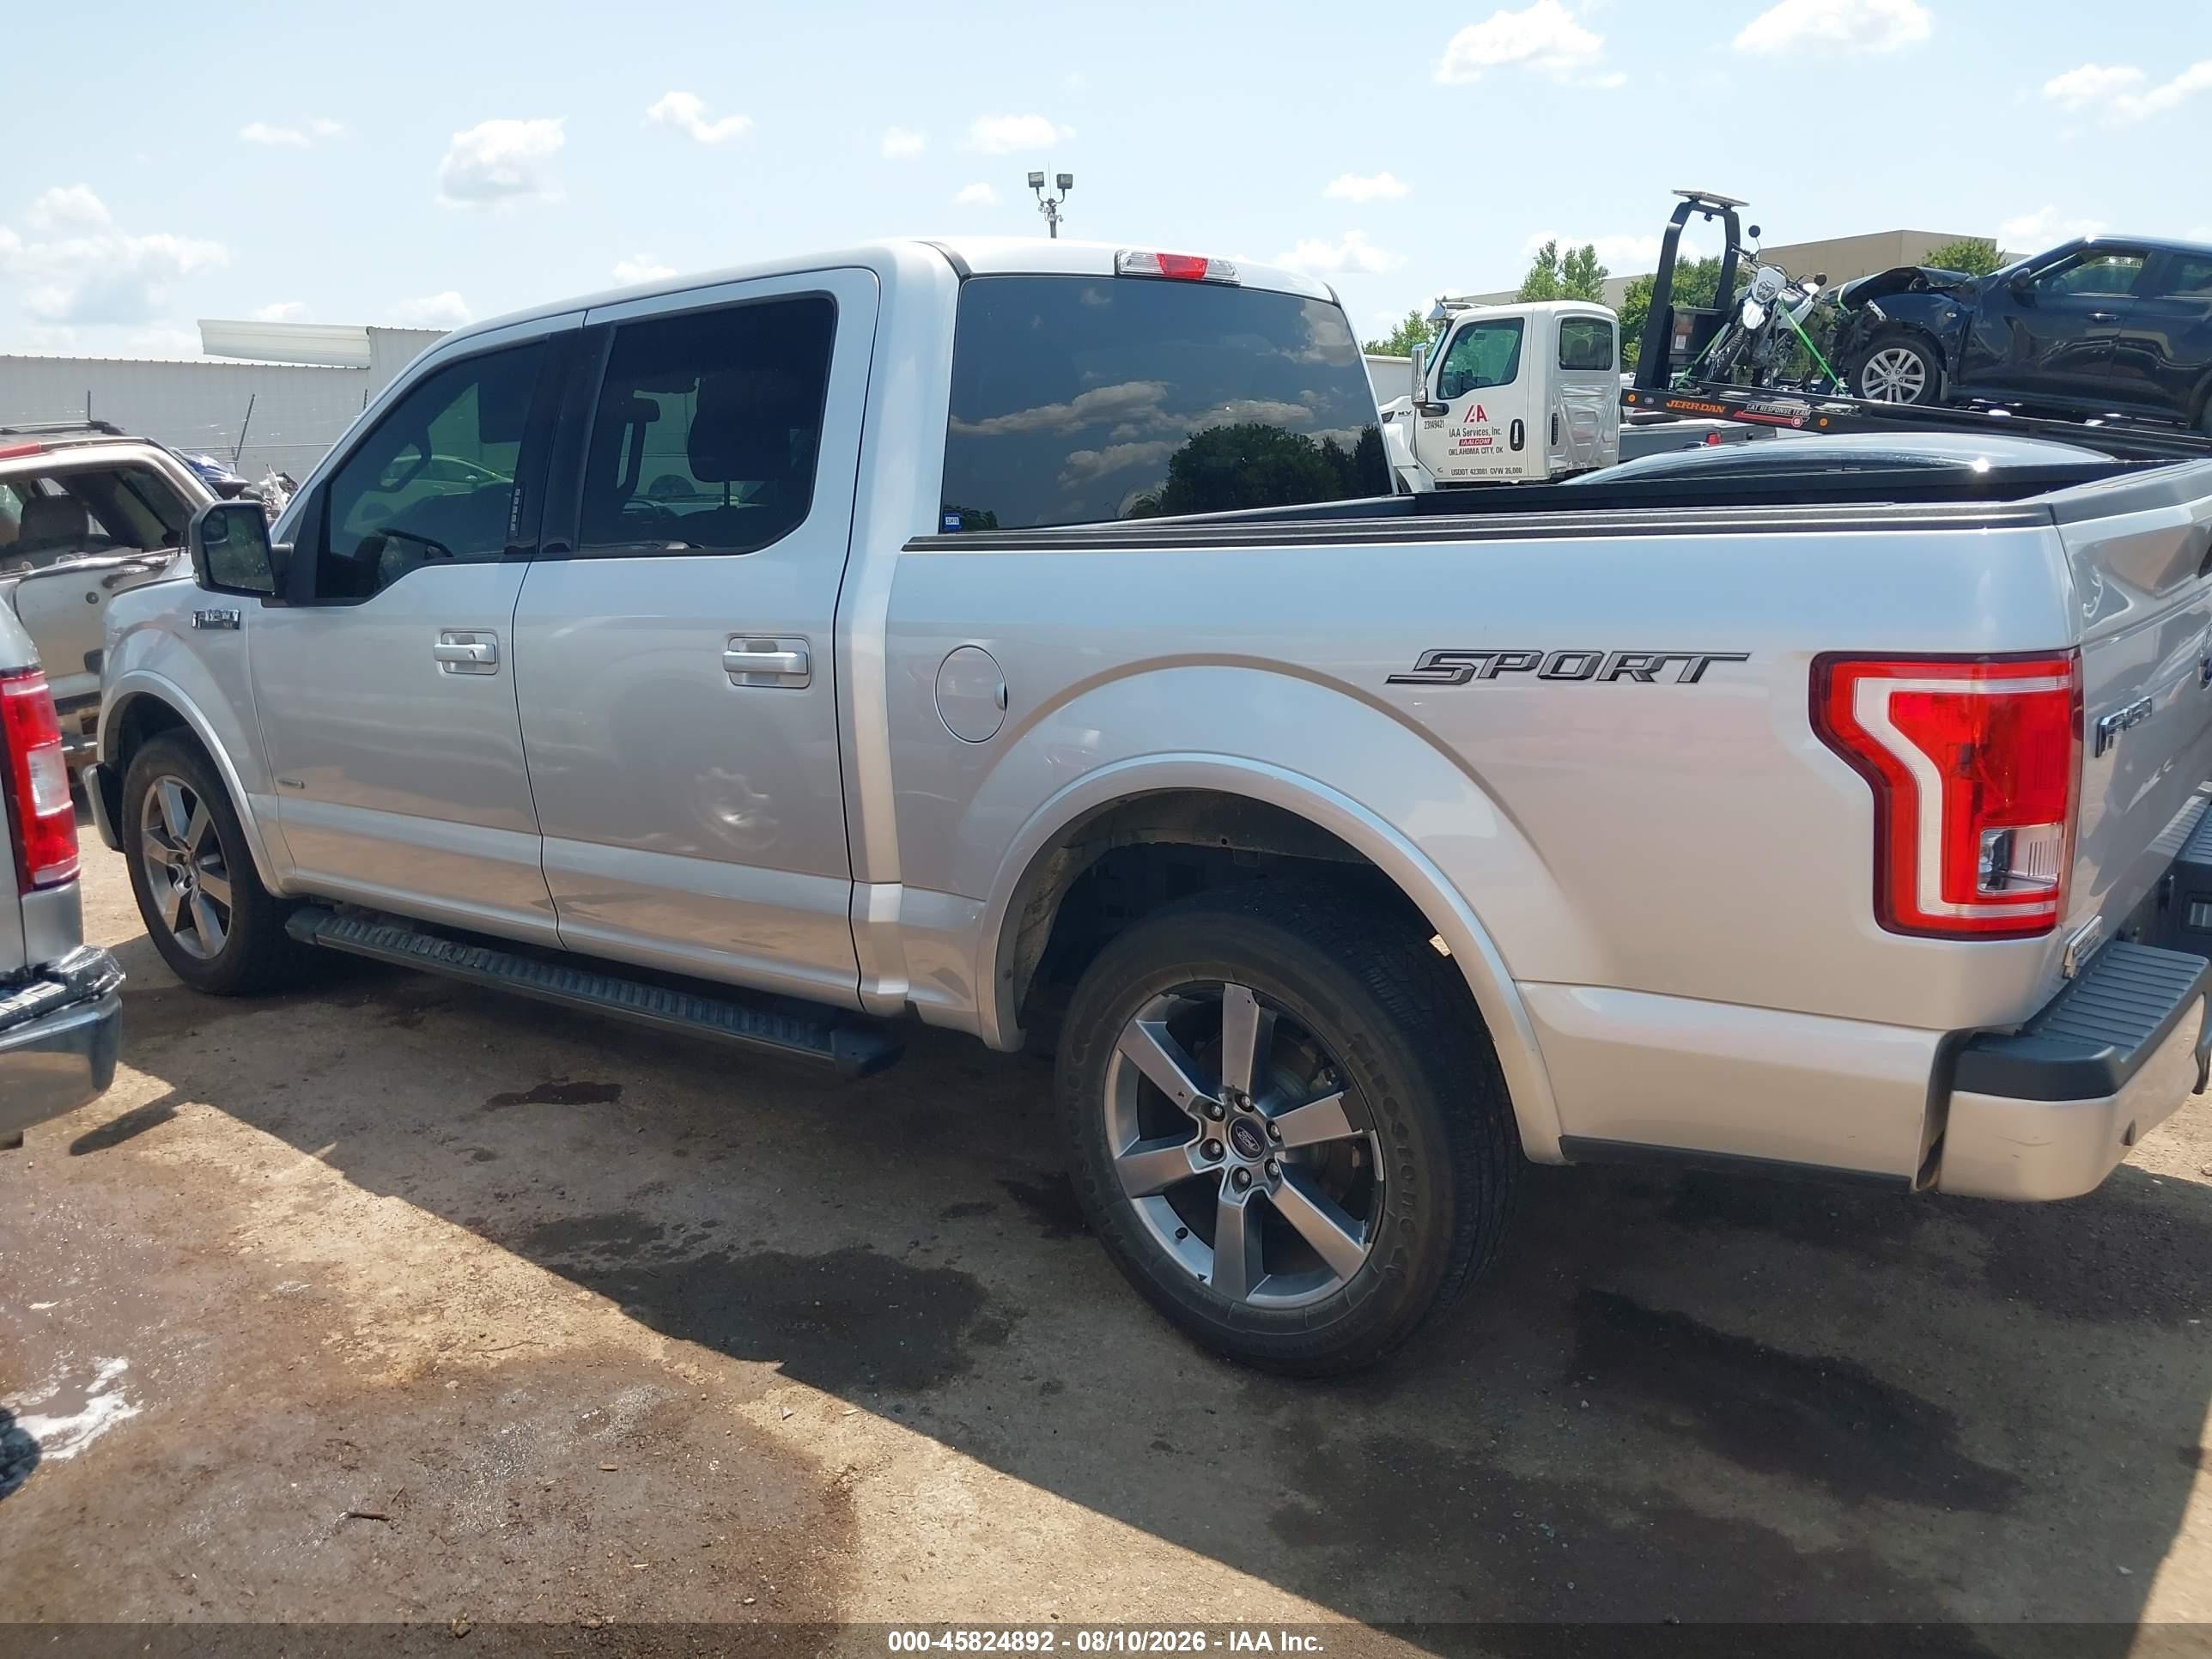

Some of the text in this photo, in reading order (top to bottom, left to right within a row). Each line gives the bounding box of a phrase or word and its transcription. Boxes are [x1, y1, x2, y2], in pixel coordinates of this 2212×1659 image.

[1759, 405, 1791, 415] RESPONSE
[1449, 426, 1503, 438] IAA Services, Inc.
[1385, 649, 1750, 685] SPORT
